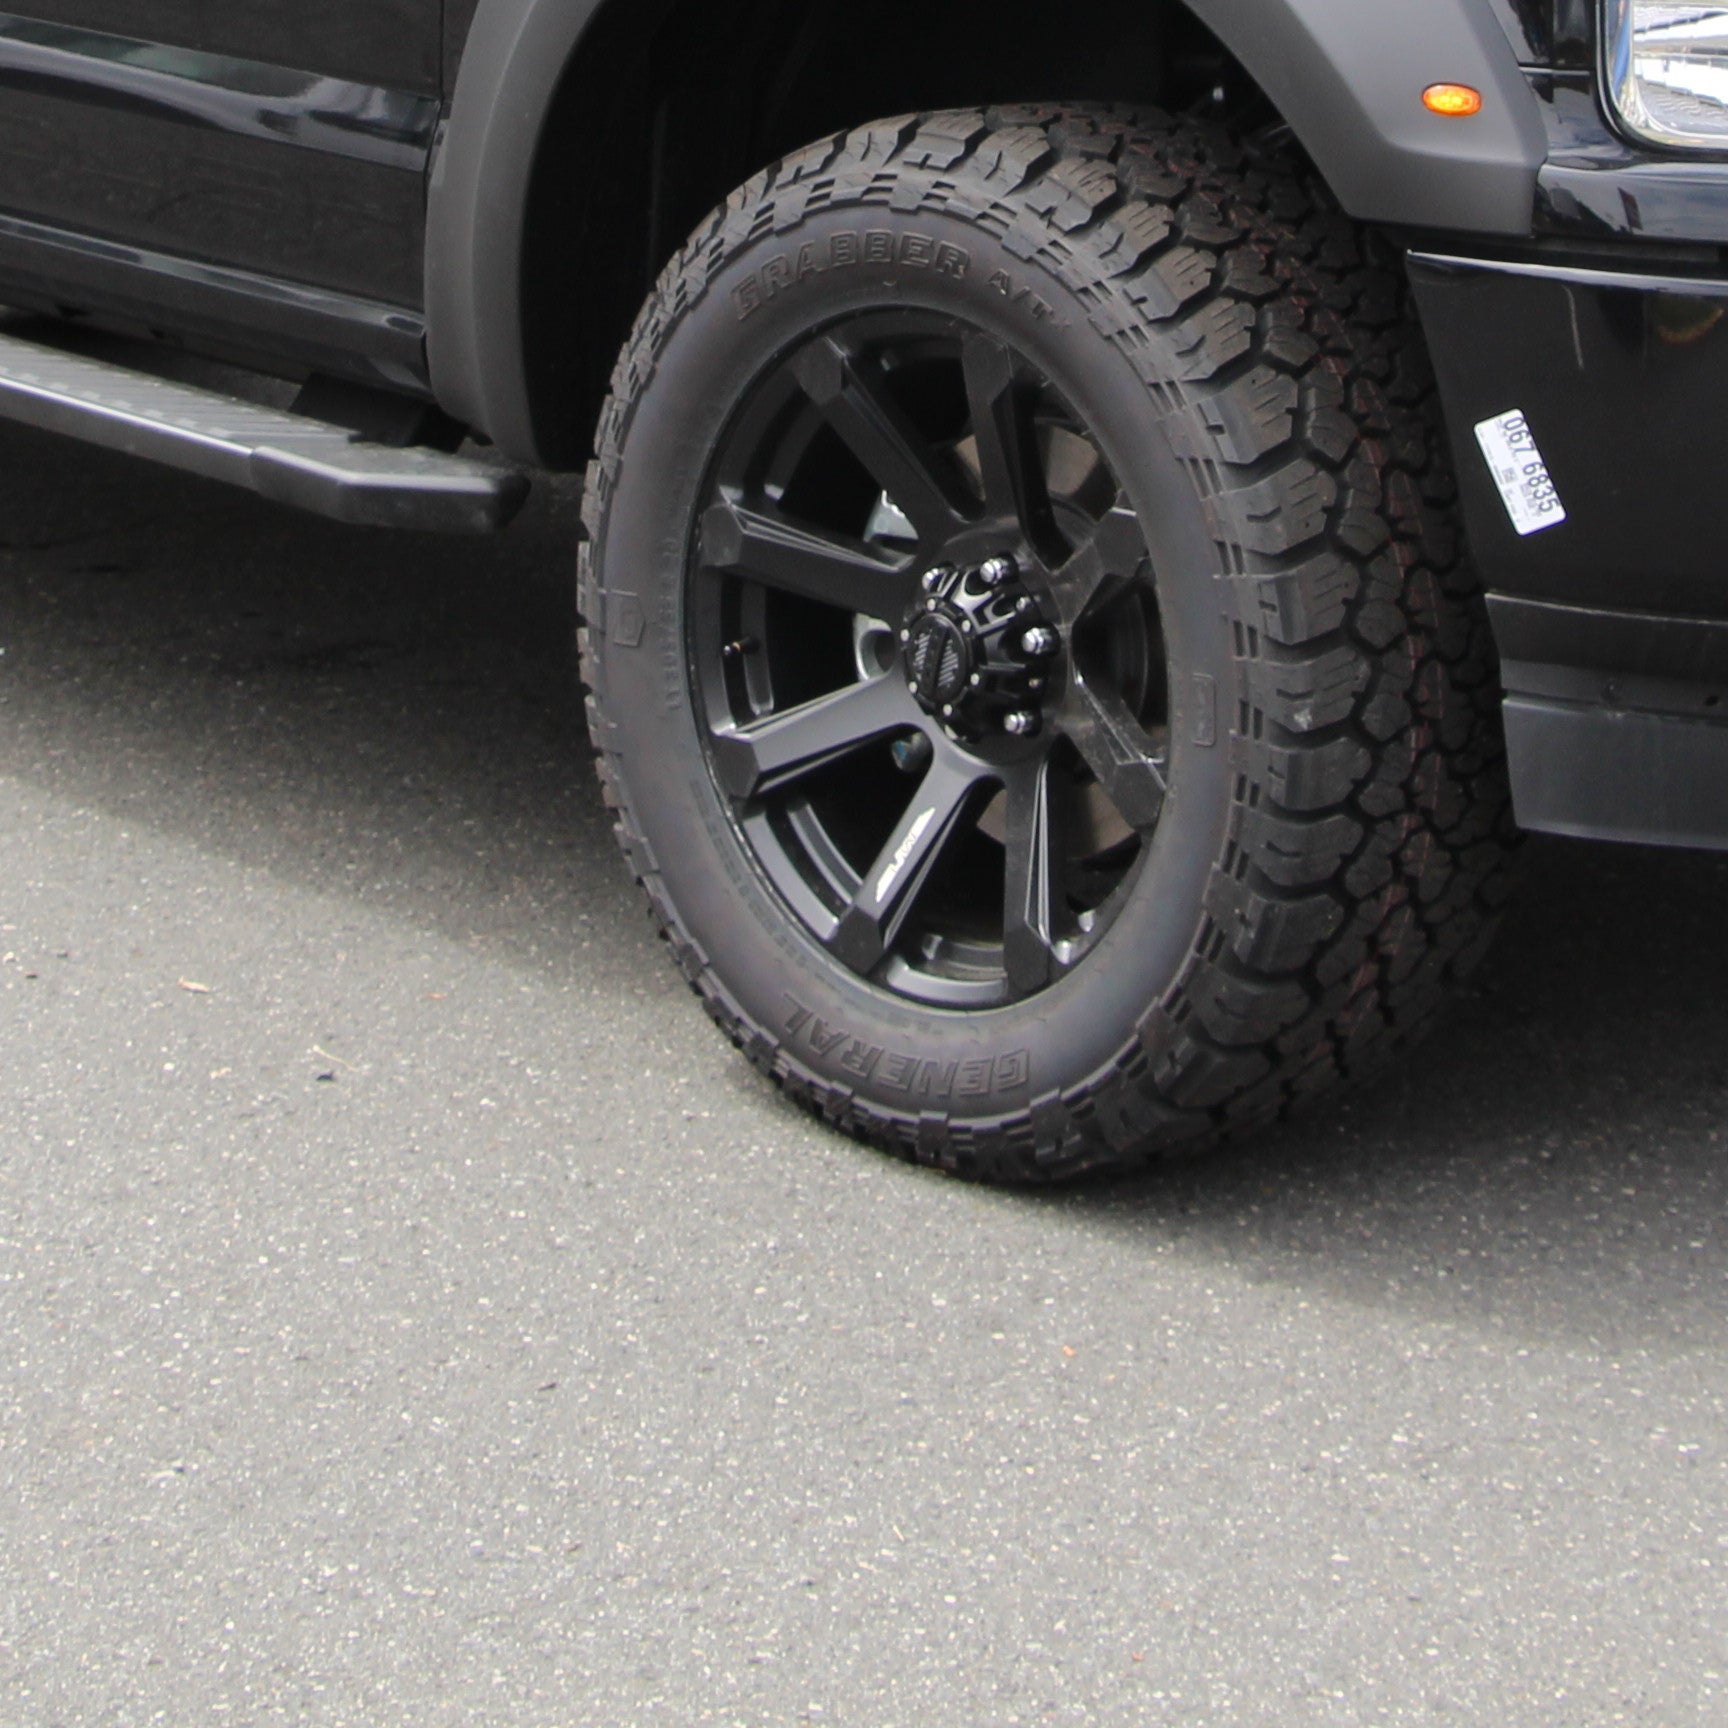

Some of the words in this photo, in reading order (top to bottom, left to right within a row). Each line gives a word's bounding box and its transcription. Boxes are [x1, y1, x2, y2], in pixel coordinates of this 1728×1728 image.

[729, 227, 971, 322] GRABBER
[1503, 416, 1536, 457] 067
[1522, 460, 1561, 513] 6835
[783, 990, 1030, 1099] GENERAL
